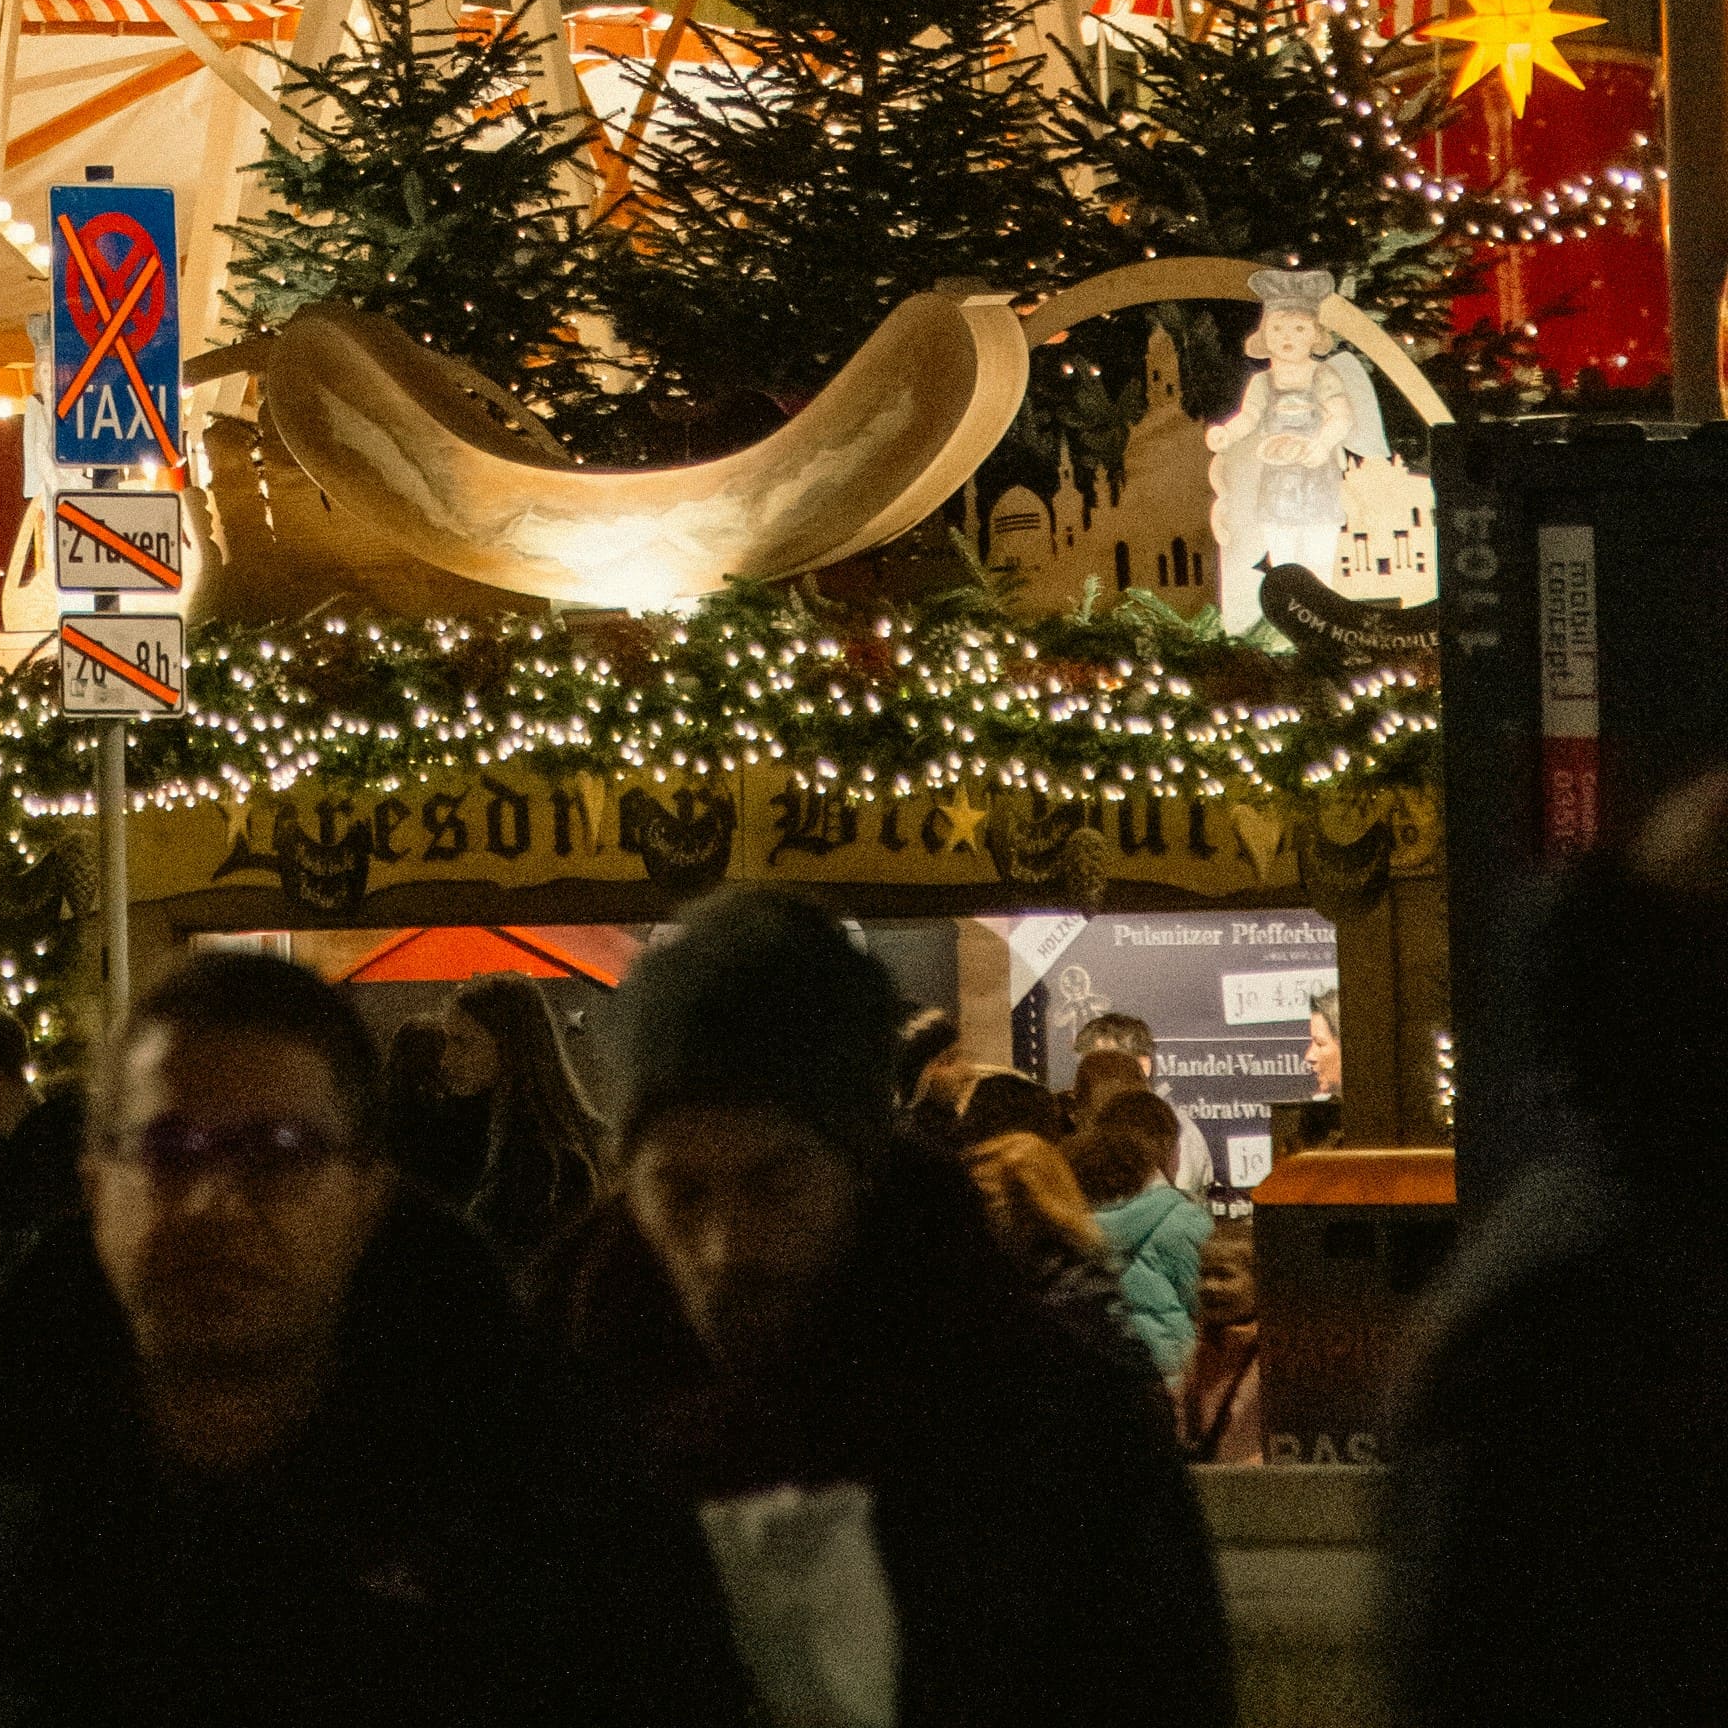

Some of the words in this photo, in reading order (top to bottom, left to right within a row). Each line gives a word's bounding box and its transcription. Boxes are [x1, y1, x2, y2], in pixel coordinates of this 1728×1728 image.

[74, 384, 167, 440] TAXI
[1288, 597, 1327, 633] VOM
[1113, 923, 1224, 946] Pulsnitzer
[1234, 983, 1260, 1019] je
[1238, 1146, 1264, 1182] je
